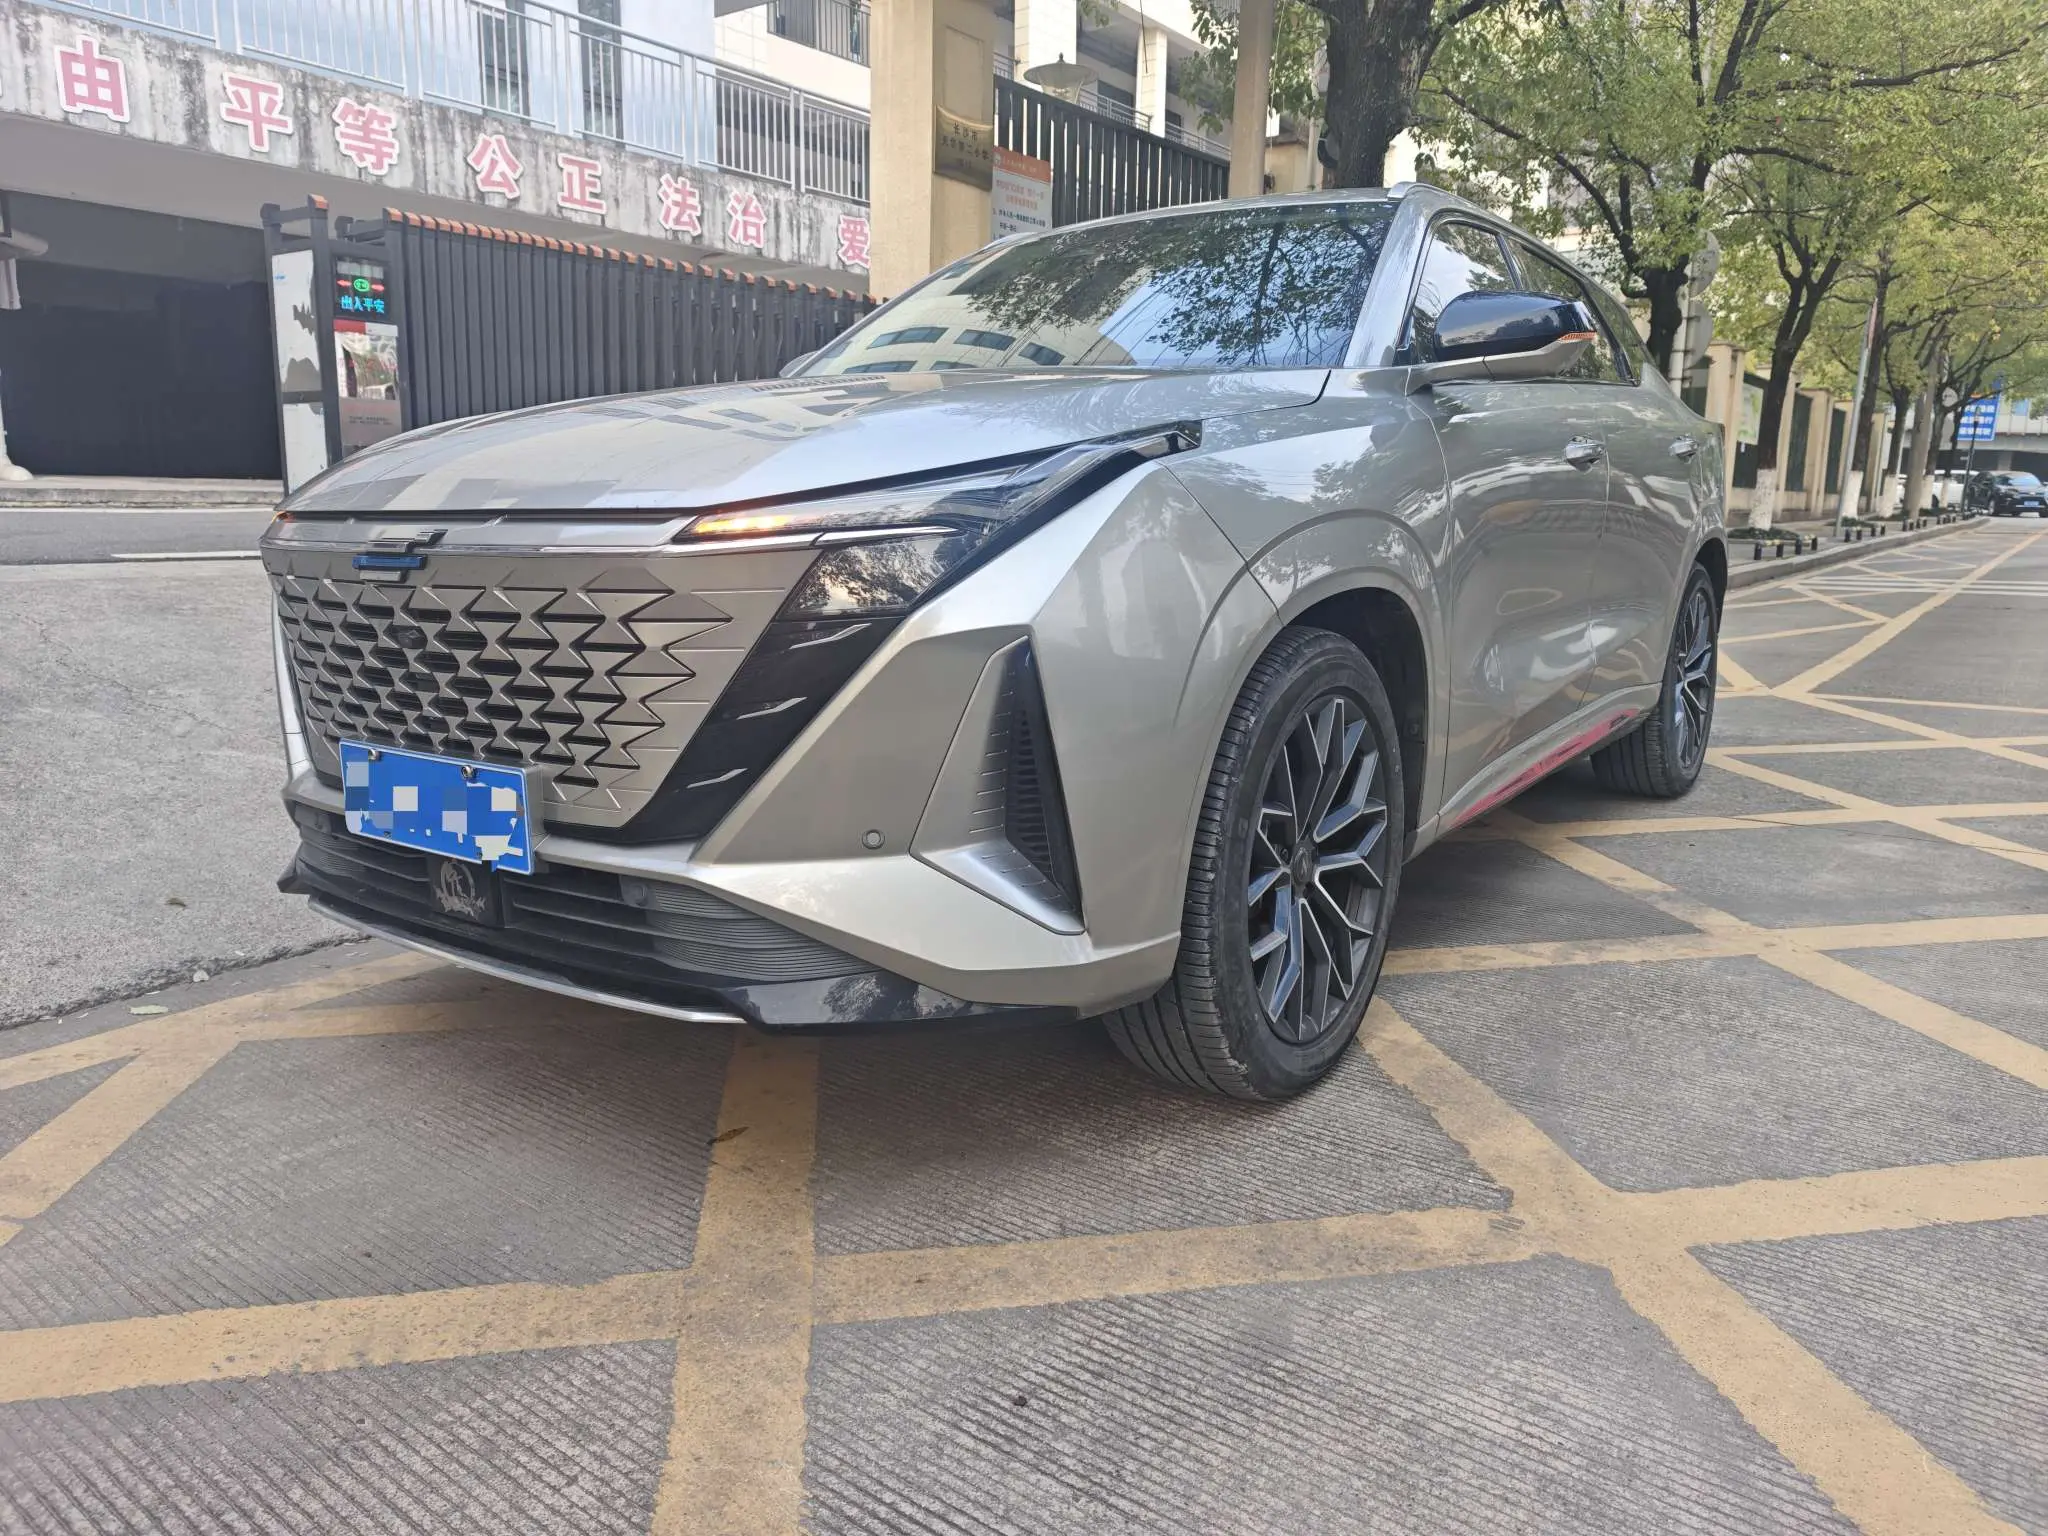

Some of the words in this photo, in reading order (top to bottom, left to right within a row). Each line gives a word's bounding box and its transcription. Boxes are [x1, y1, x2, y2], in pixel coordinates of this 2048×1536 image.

[55, 35, 130, 122] 由
[837, 214, 870, 268] 爱
[340, 295, 385, 313] 出入平安
